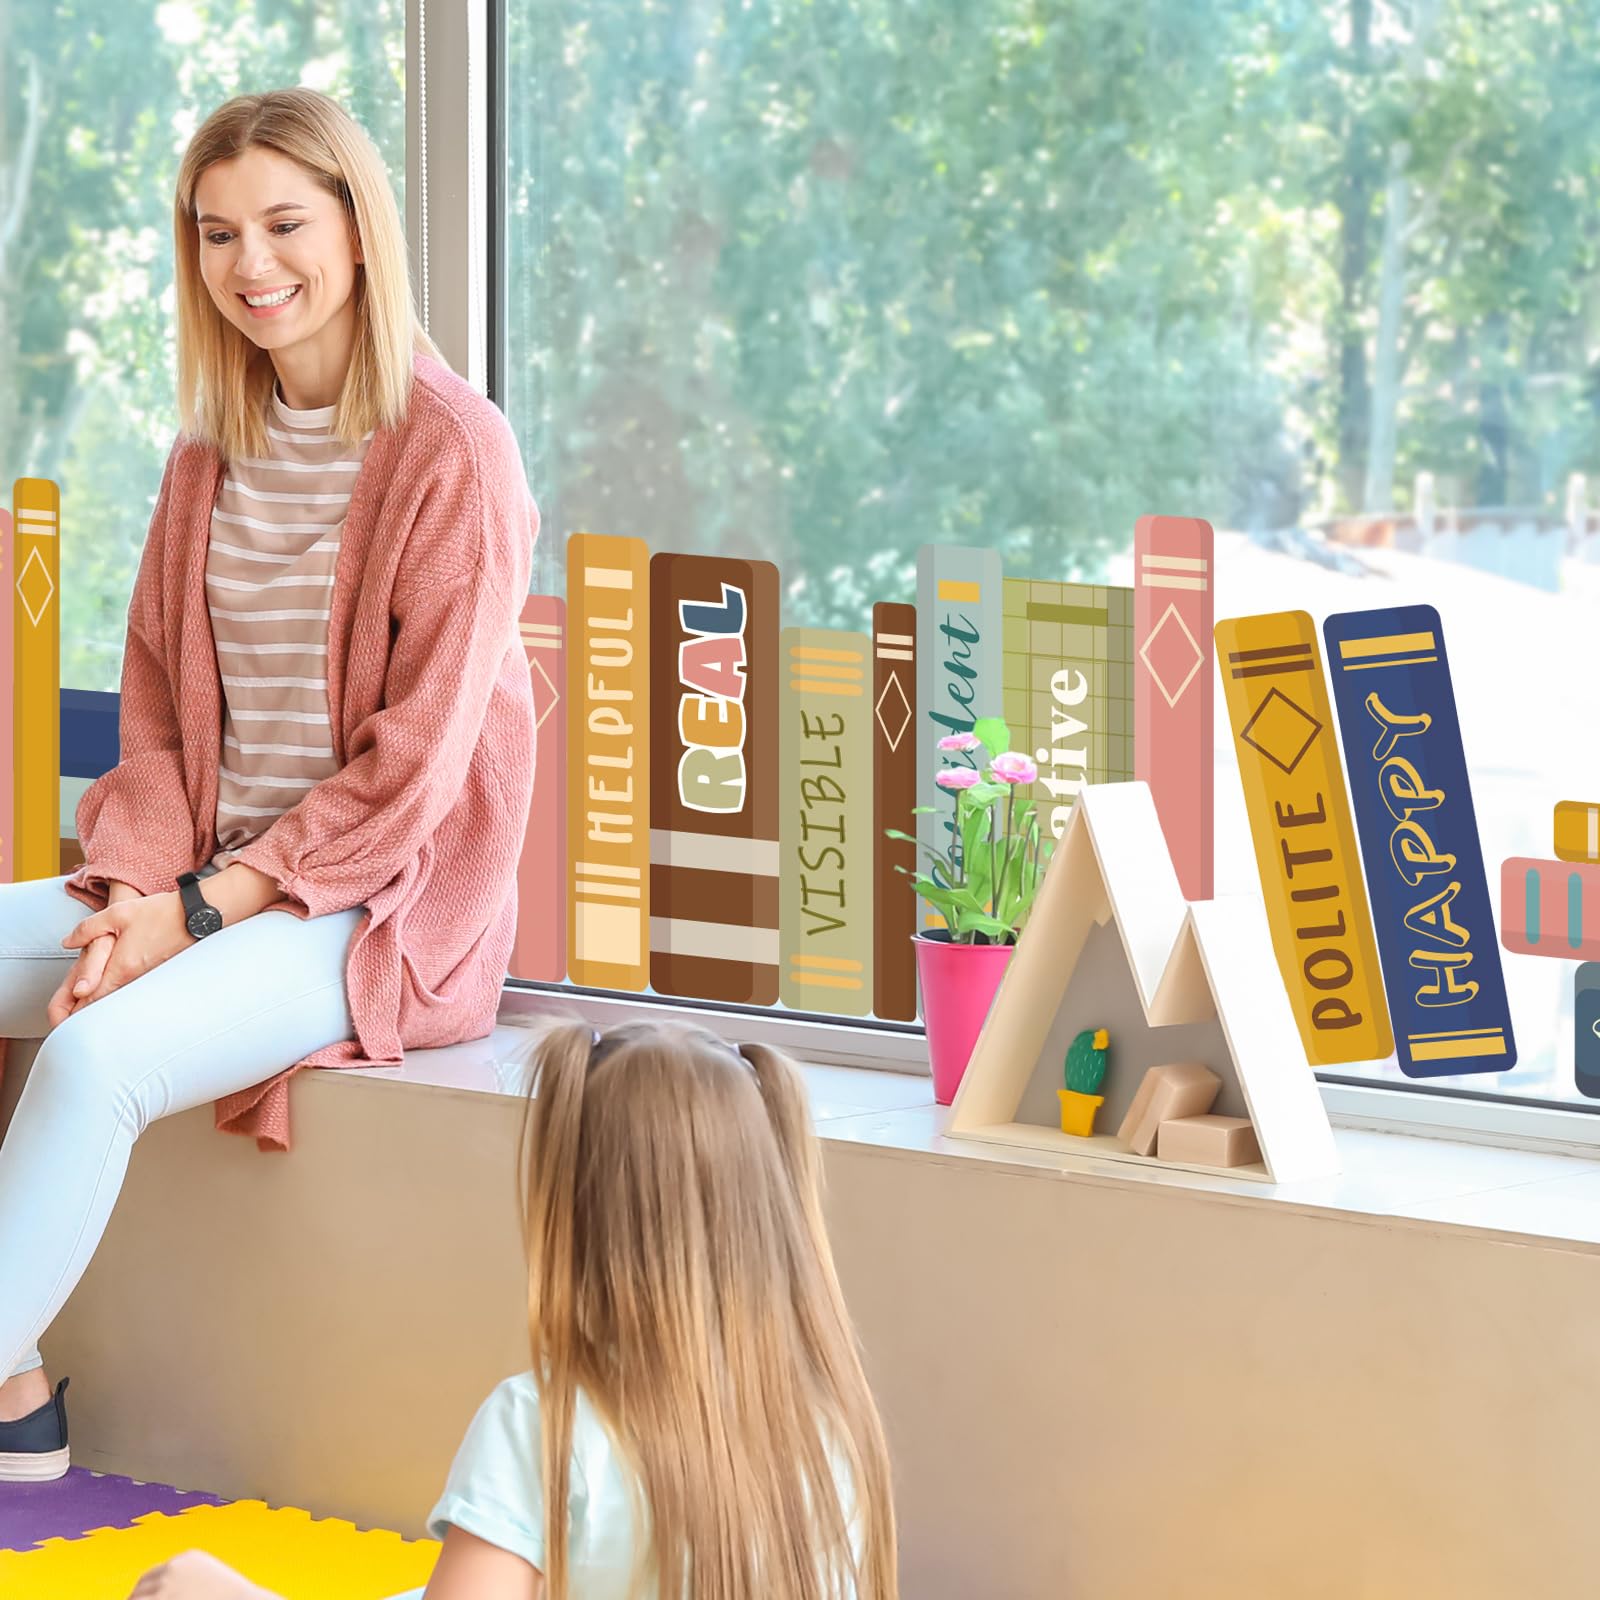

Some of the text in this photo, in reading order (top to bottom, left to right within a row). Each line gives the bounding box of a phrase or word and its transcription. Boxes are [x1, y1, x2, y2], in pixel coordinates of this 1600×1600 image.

[587, 608, 634, 843] HELPFUL
[678, 582, 747, 813] REAL
[799, 710, 846, 936] VISIBLE
[1275, 792, 1363, 1030] POLITE
[1365, 692, 1480, 1008] HAPPY
